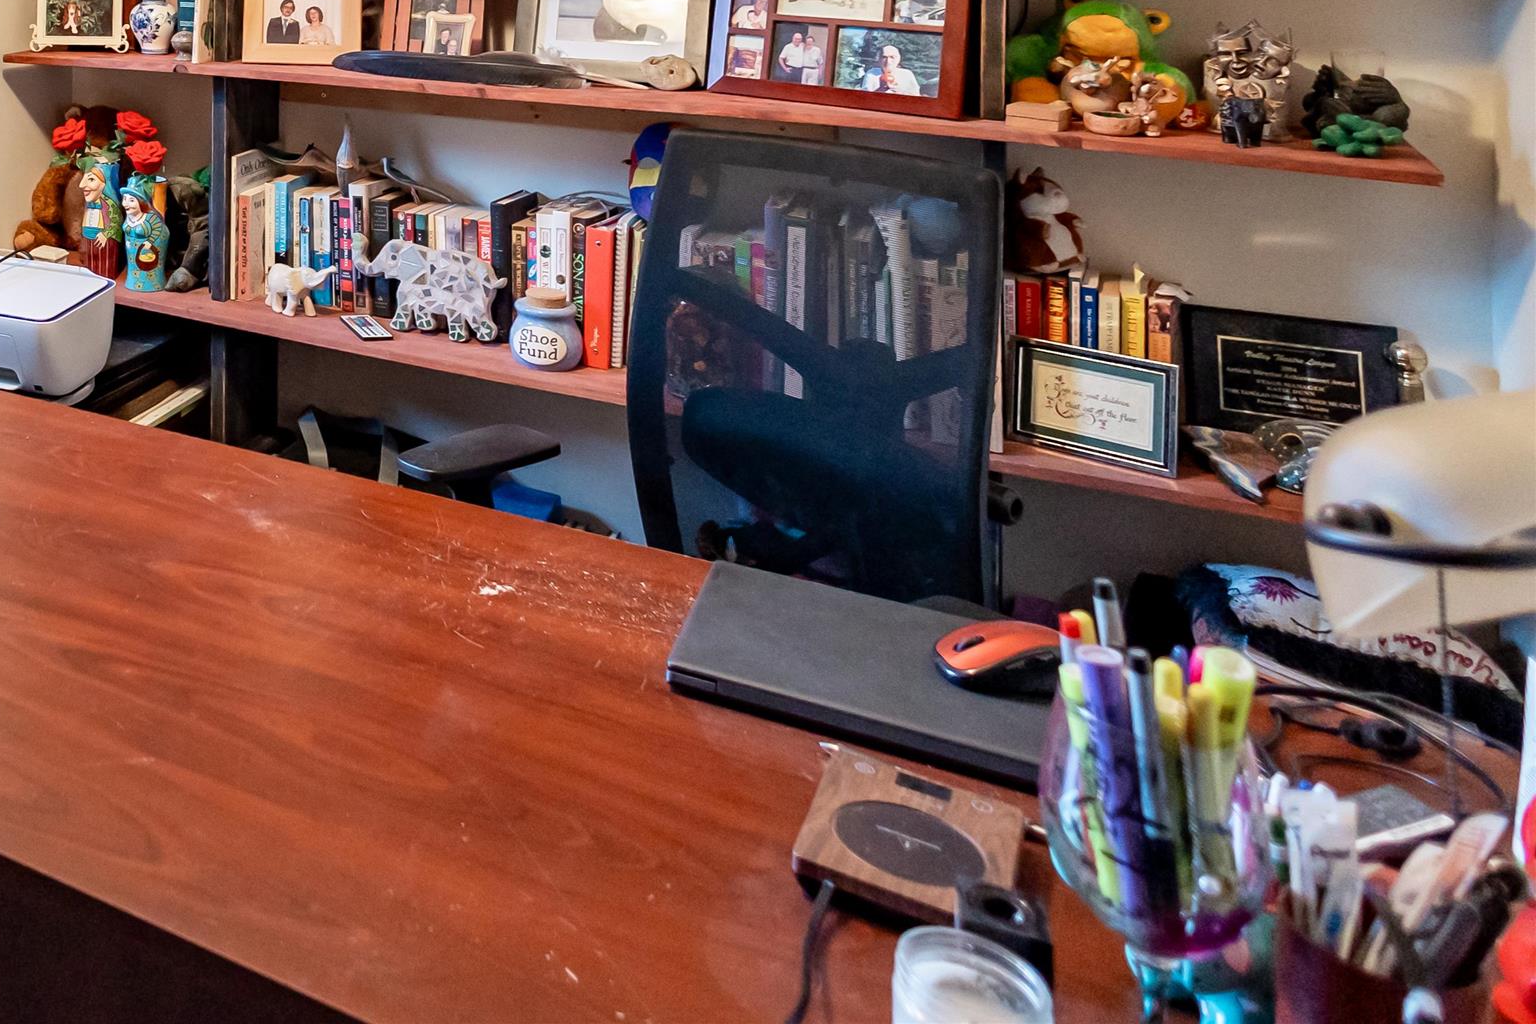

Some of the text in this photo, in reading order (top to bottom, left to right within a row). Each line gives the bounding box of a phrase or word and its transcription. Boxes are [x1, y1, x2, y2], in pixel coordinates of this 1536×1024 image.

[279, 191, 287, 257] COLD MOUNTAIN
[481, 236, 490, 260] JAMES
[573, 252, 584, 282] SON
[1049, 287, 1064, 342] HAWK MOUN
[519, 342, 558, 361] Fund
[520, 329, 558, 347] Shoe
